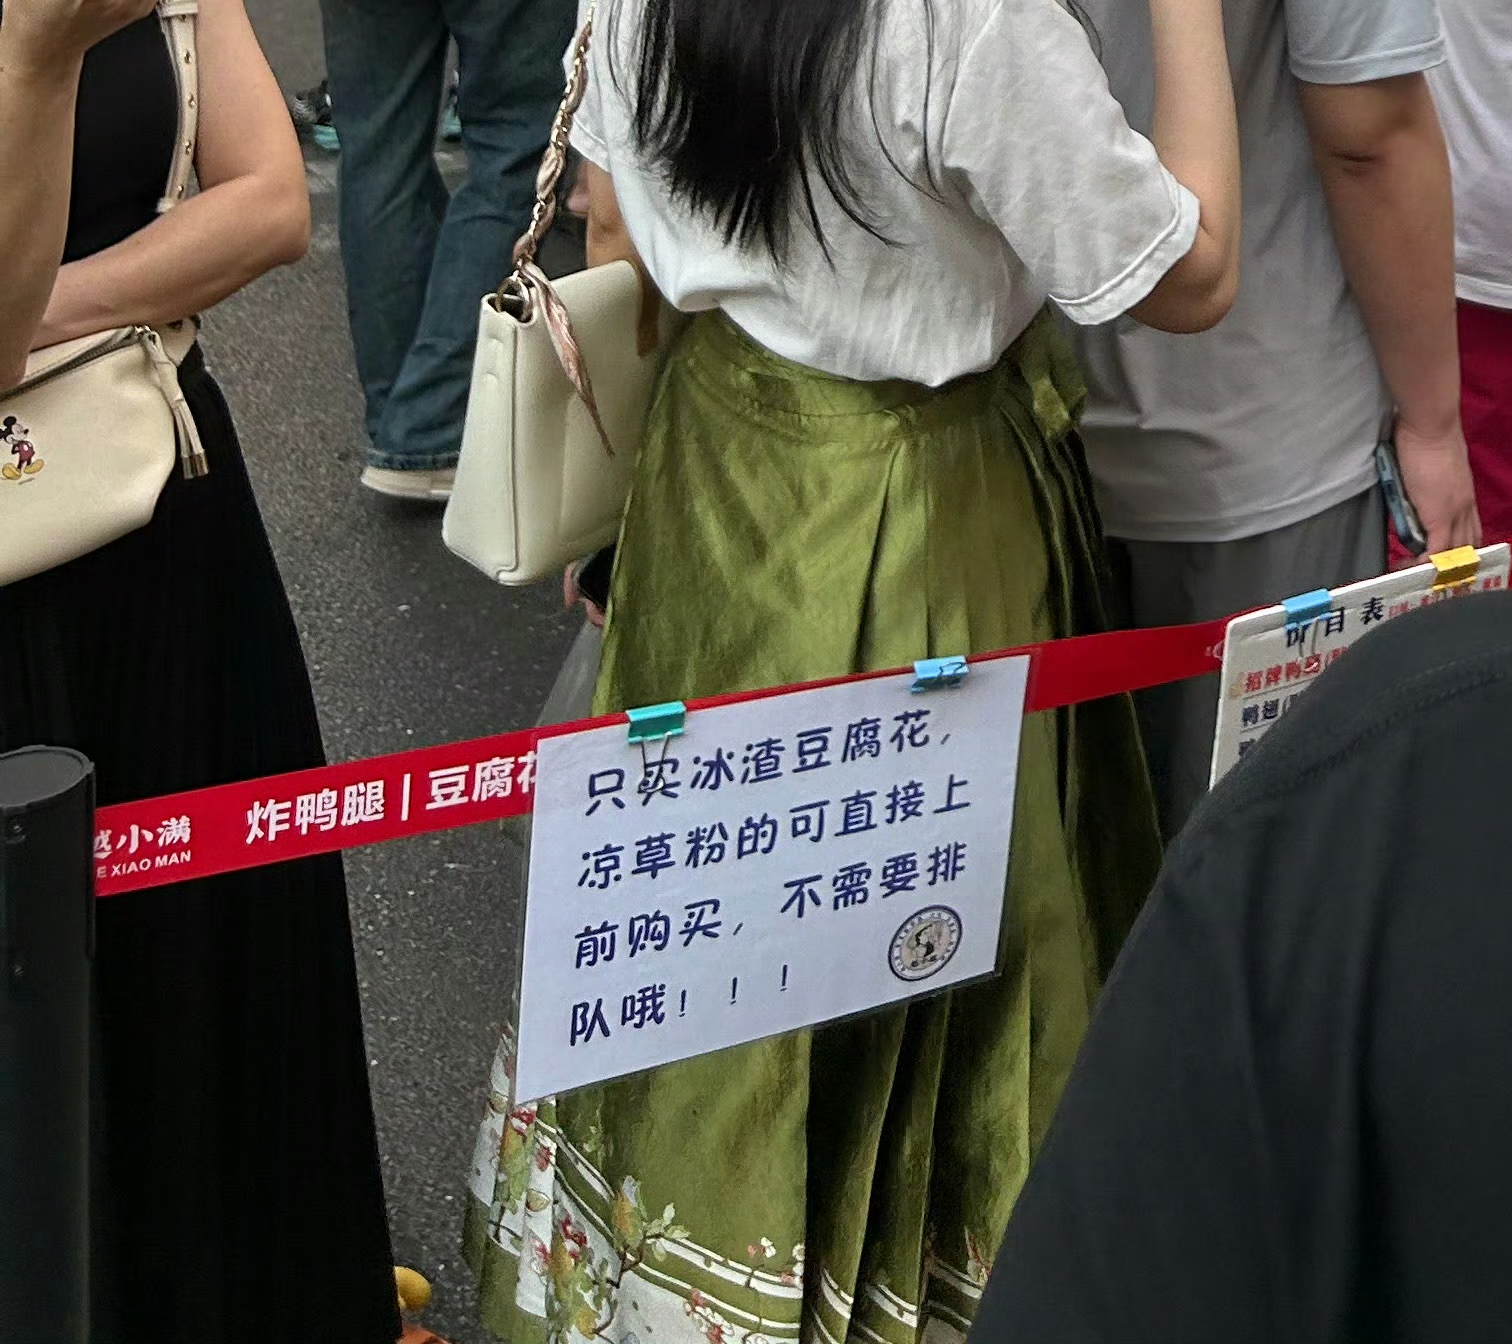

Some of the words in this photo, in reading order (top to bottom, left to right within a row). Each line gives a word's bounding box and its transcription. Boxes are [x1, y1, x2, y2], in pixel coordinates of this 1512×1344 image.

[111, 860, 151, 877] XIAO
[155, 849, 191, 868] MAN
[577, 774, 970, 890] 凉草粉的可直接上
